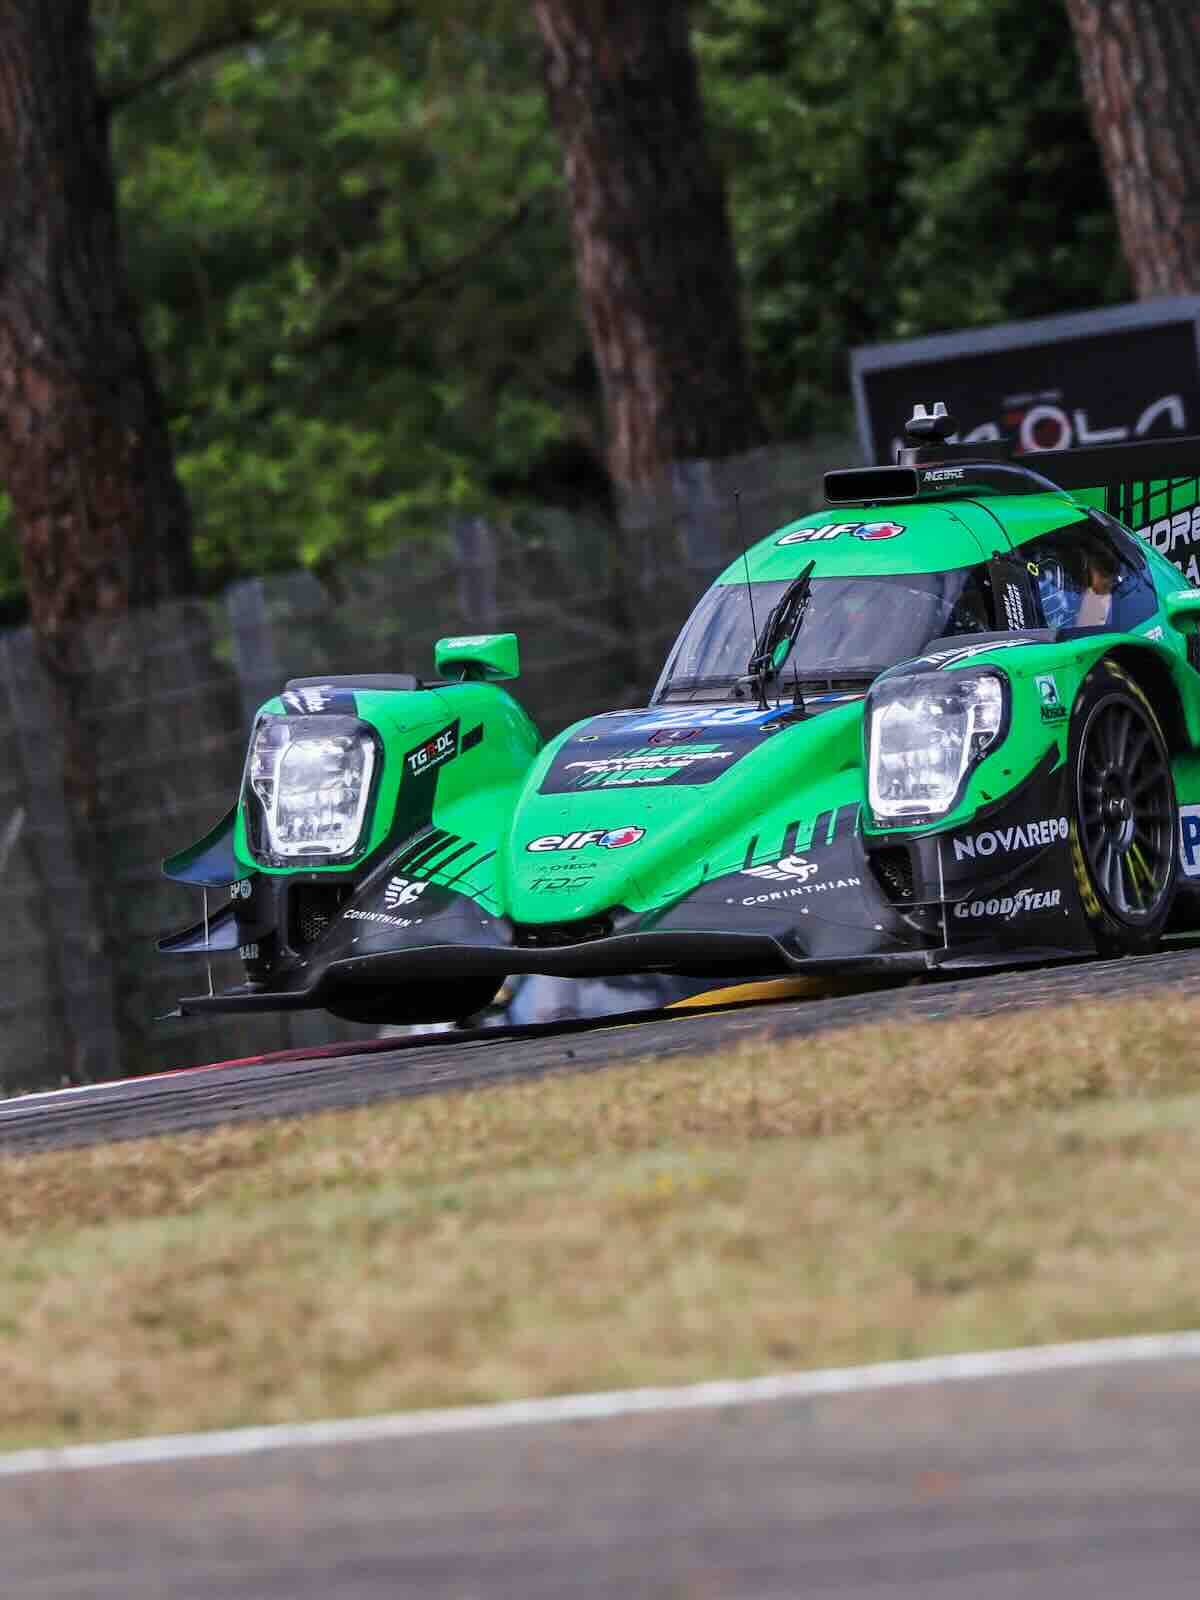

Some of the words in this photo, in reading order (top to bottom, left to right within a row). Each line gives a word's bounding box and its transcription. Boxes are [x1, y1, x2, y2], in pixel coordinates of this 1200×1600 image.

[775, 522, 863, 546] elf
[526, 829, 608, 852] elf
[952, 816, 1070, 861] NOVAREPO
[742, 877, 861, 906] CORINTHIAN
[953, 887, 1061, 921] GOODYEAR
[343, 909, 413, 928] CORINTHIAN
